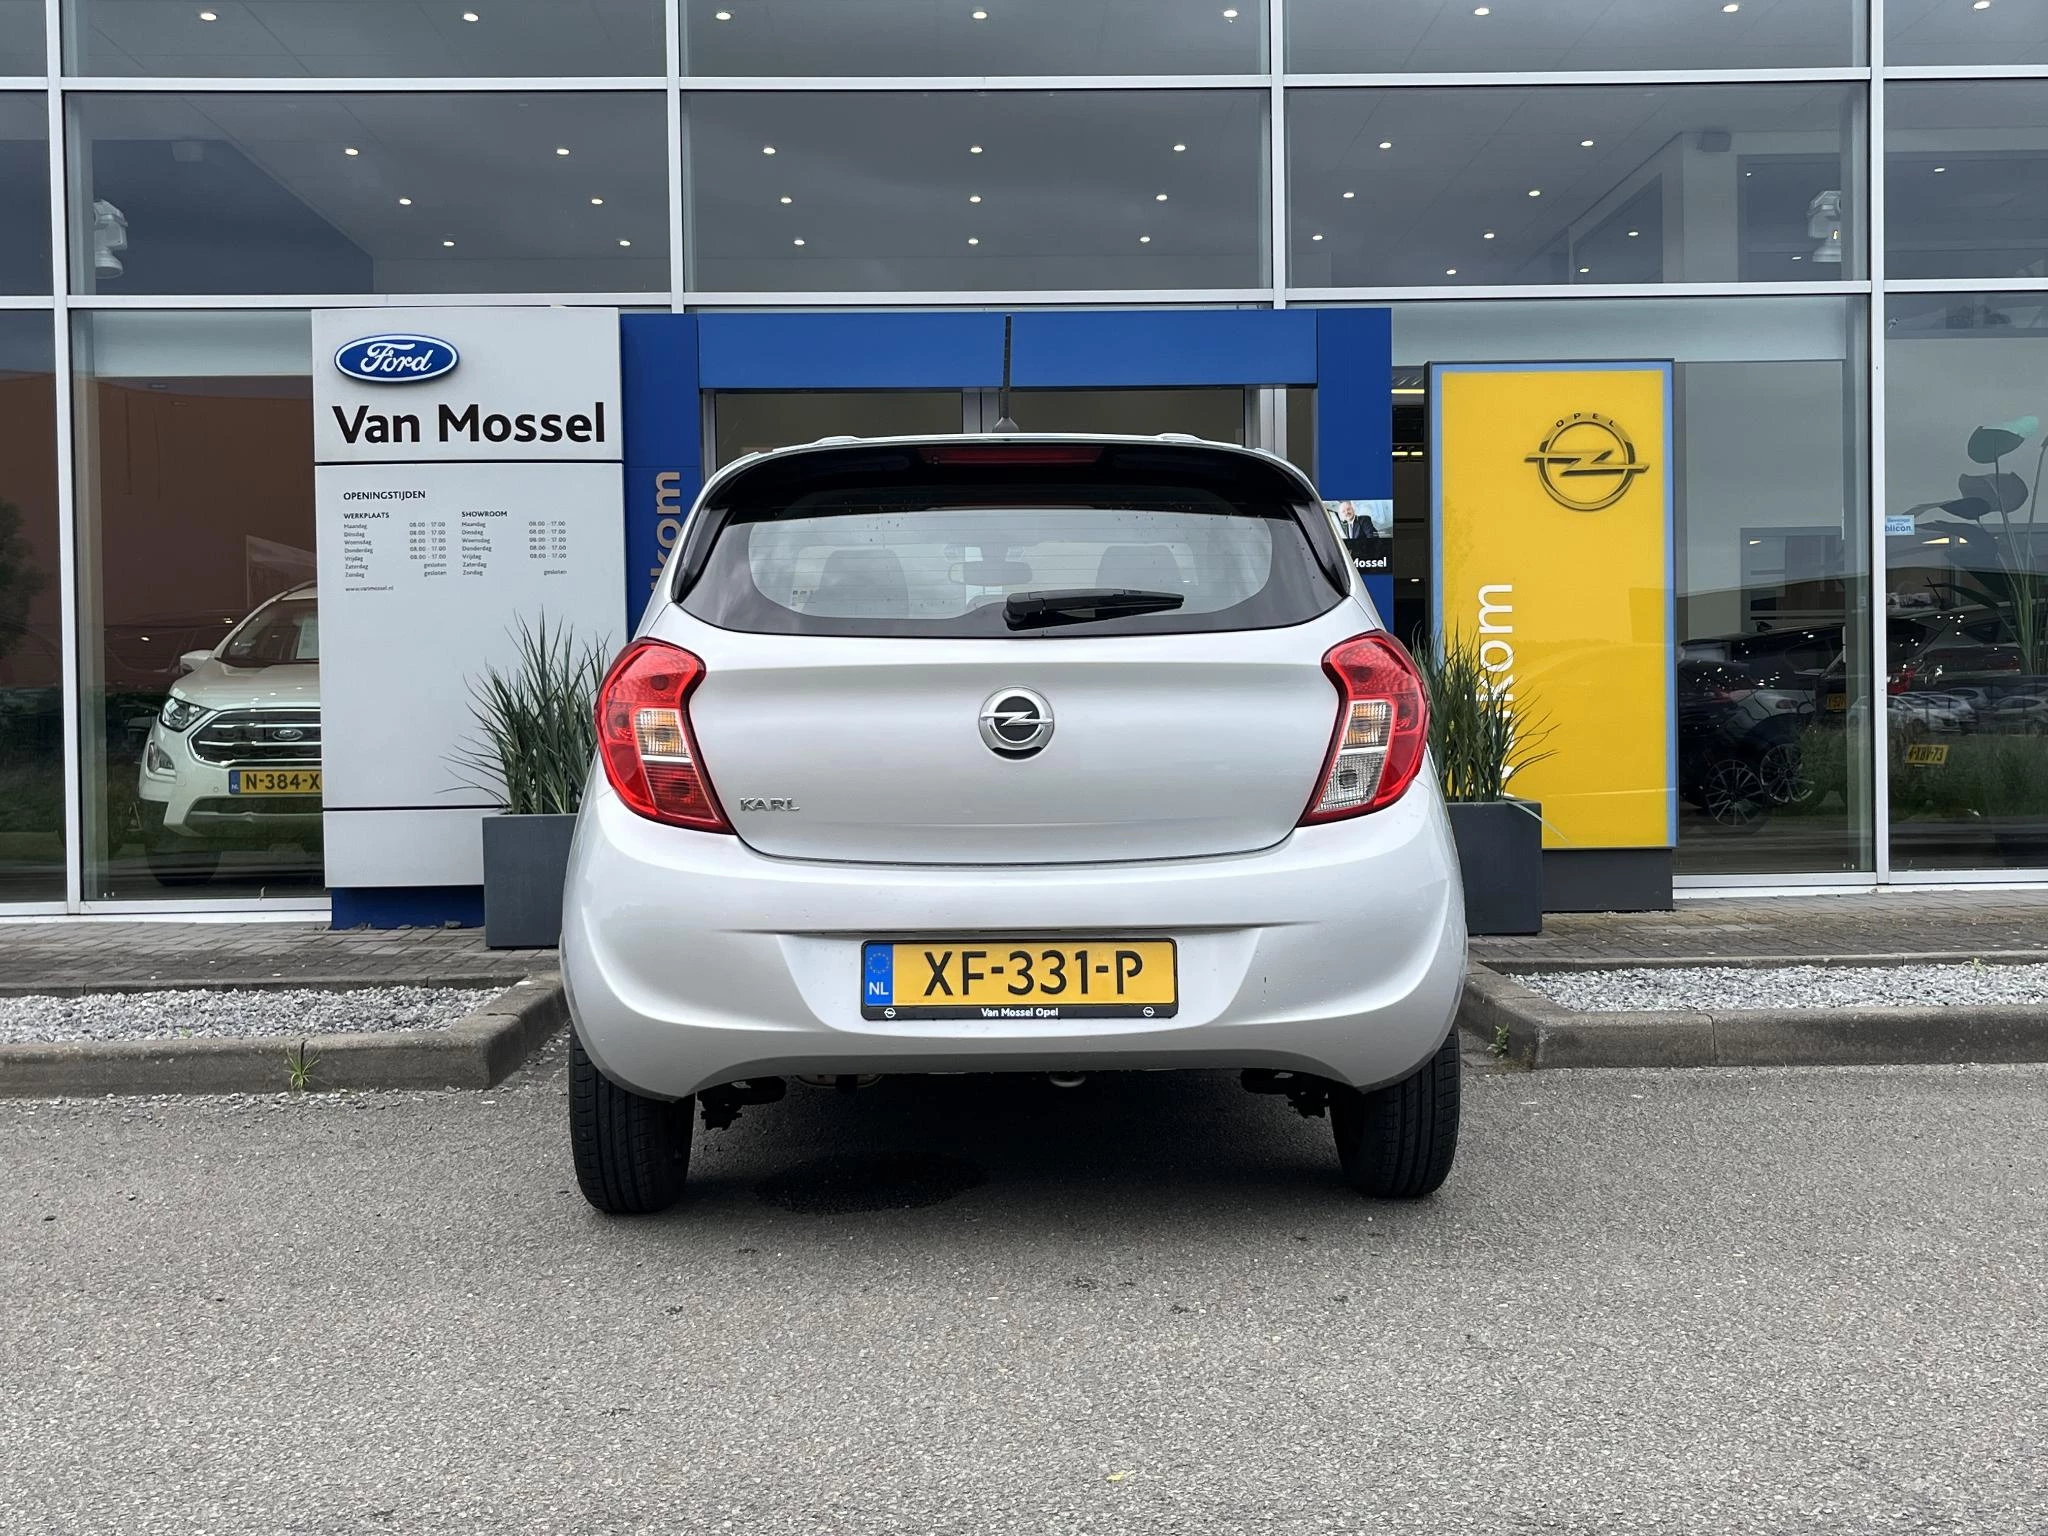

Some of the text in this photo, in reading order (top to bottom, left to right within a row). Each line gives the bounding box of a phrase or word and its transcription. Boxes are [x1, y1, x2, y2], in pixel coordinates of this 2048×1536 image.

[360, 342, 433, 372] Ford
[332, 402, 605, 444] Van Mossel
[1555, 413, 1615, 427] OPEL
[343, 490, 426, 501] OPENINGSTIJDEN
[245, 773, 321, 790] N-384-X
[740, 797, 801, 812] KARL
[868, 949, 1144, 996] NL XF-331-P
[981, 1006, 1059, 1019] Van Mossel Opel
